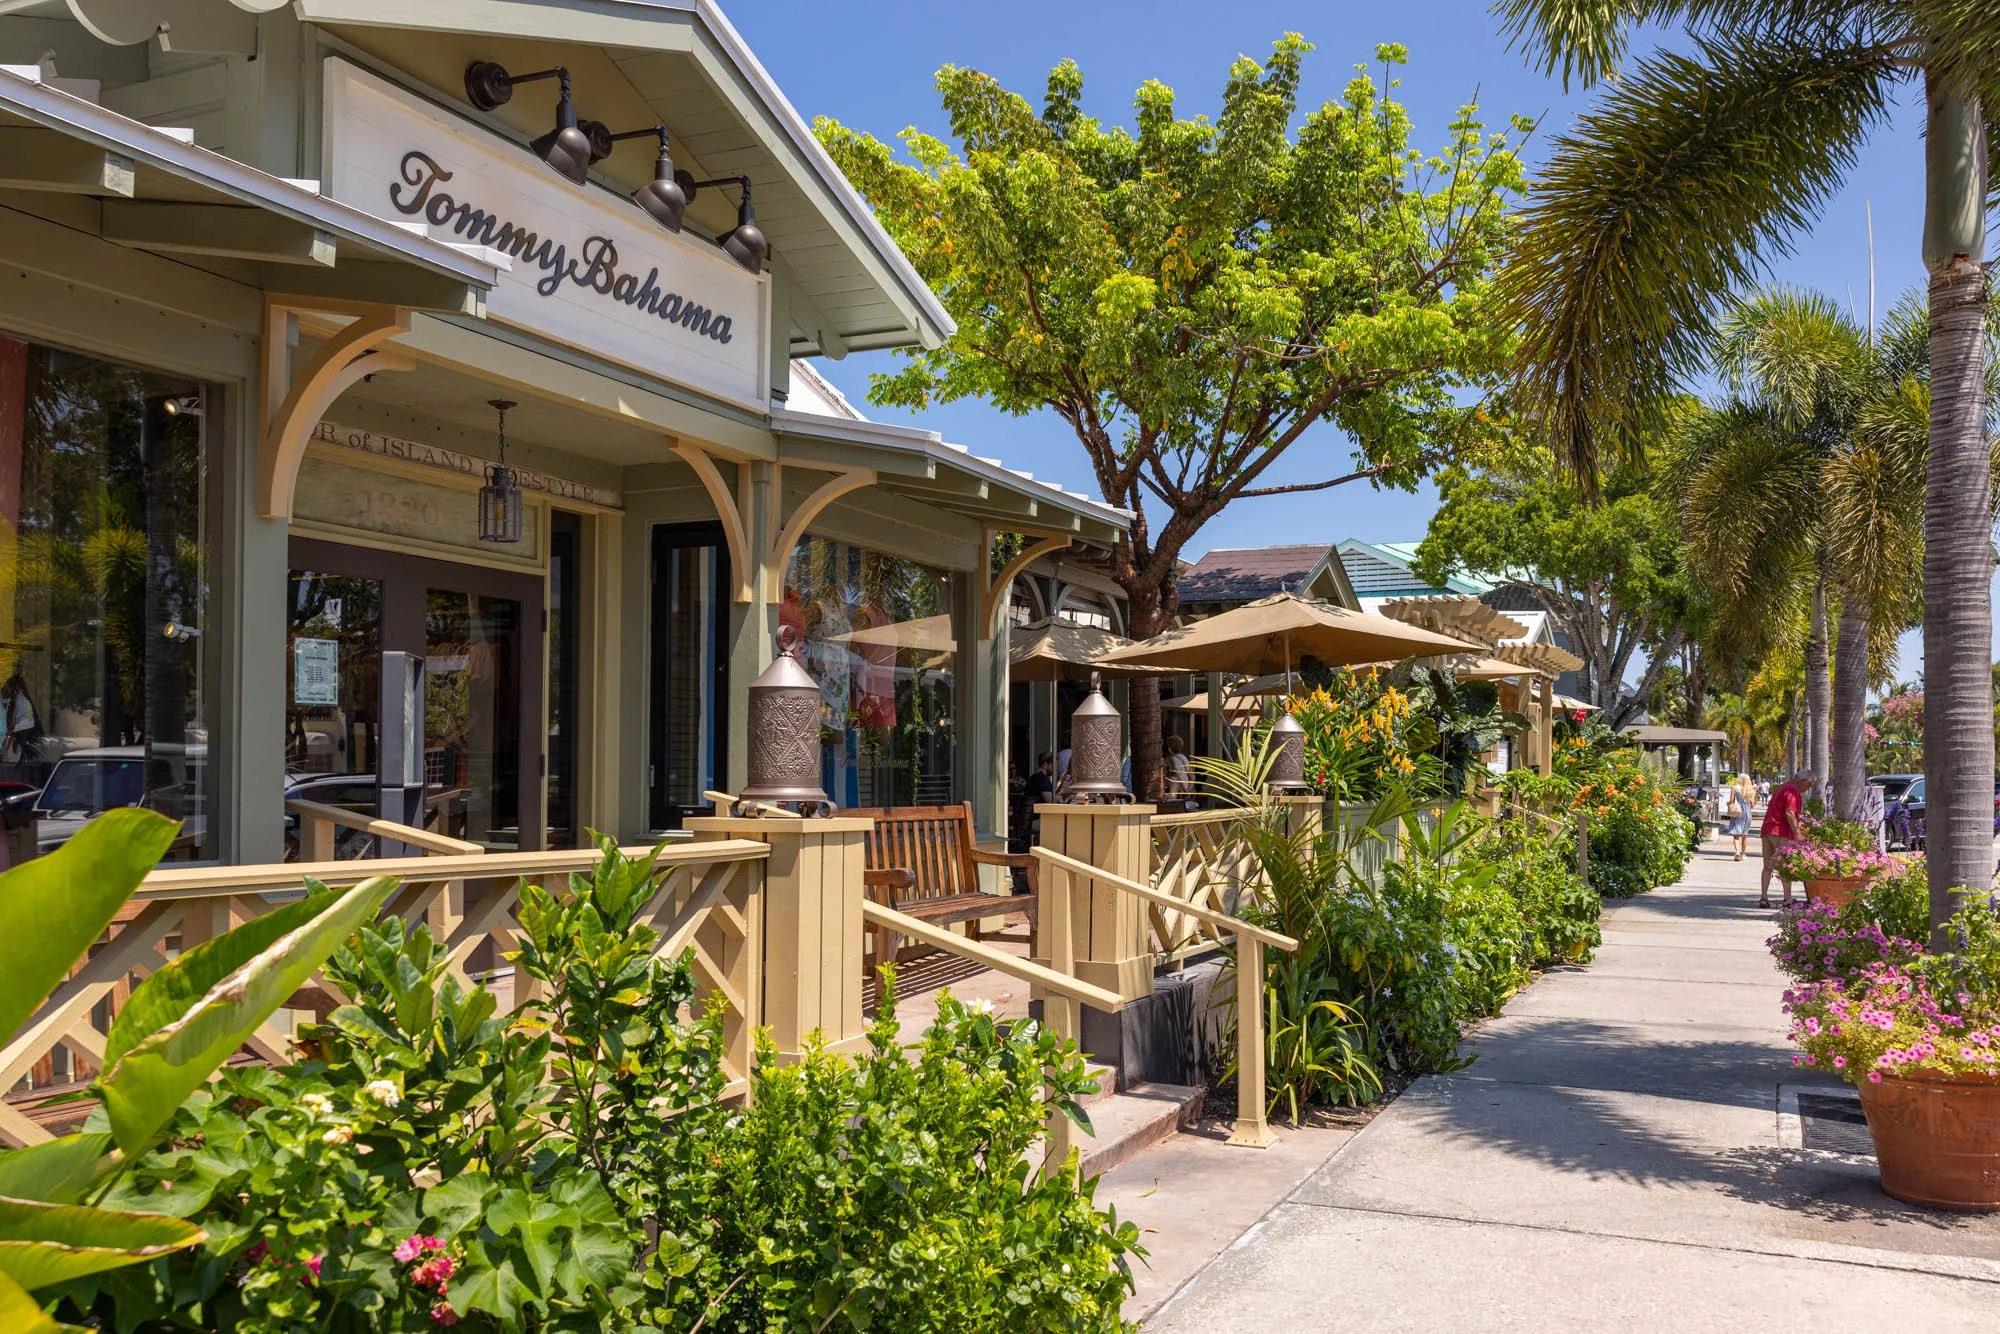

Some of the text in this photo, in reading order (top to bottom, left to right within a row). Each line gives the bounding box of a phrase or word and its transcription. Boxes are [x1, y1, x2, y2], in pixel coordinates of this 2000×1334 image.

[390, 150, 733, 345] Tommy Bahama
[348, 432, 371, 450] of
[381, 436, 473, 473] ISLAND
